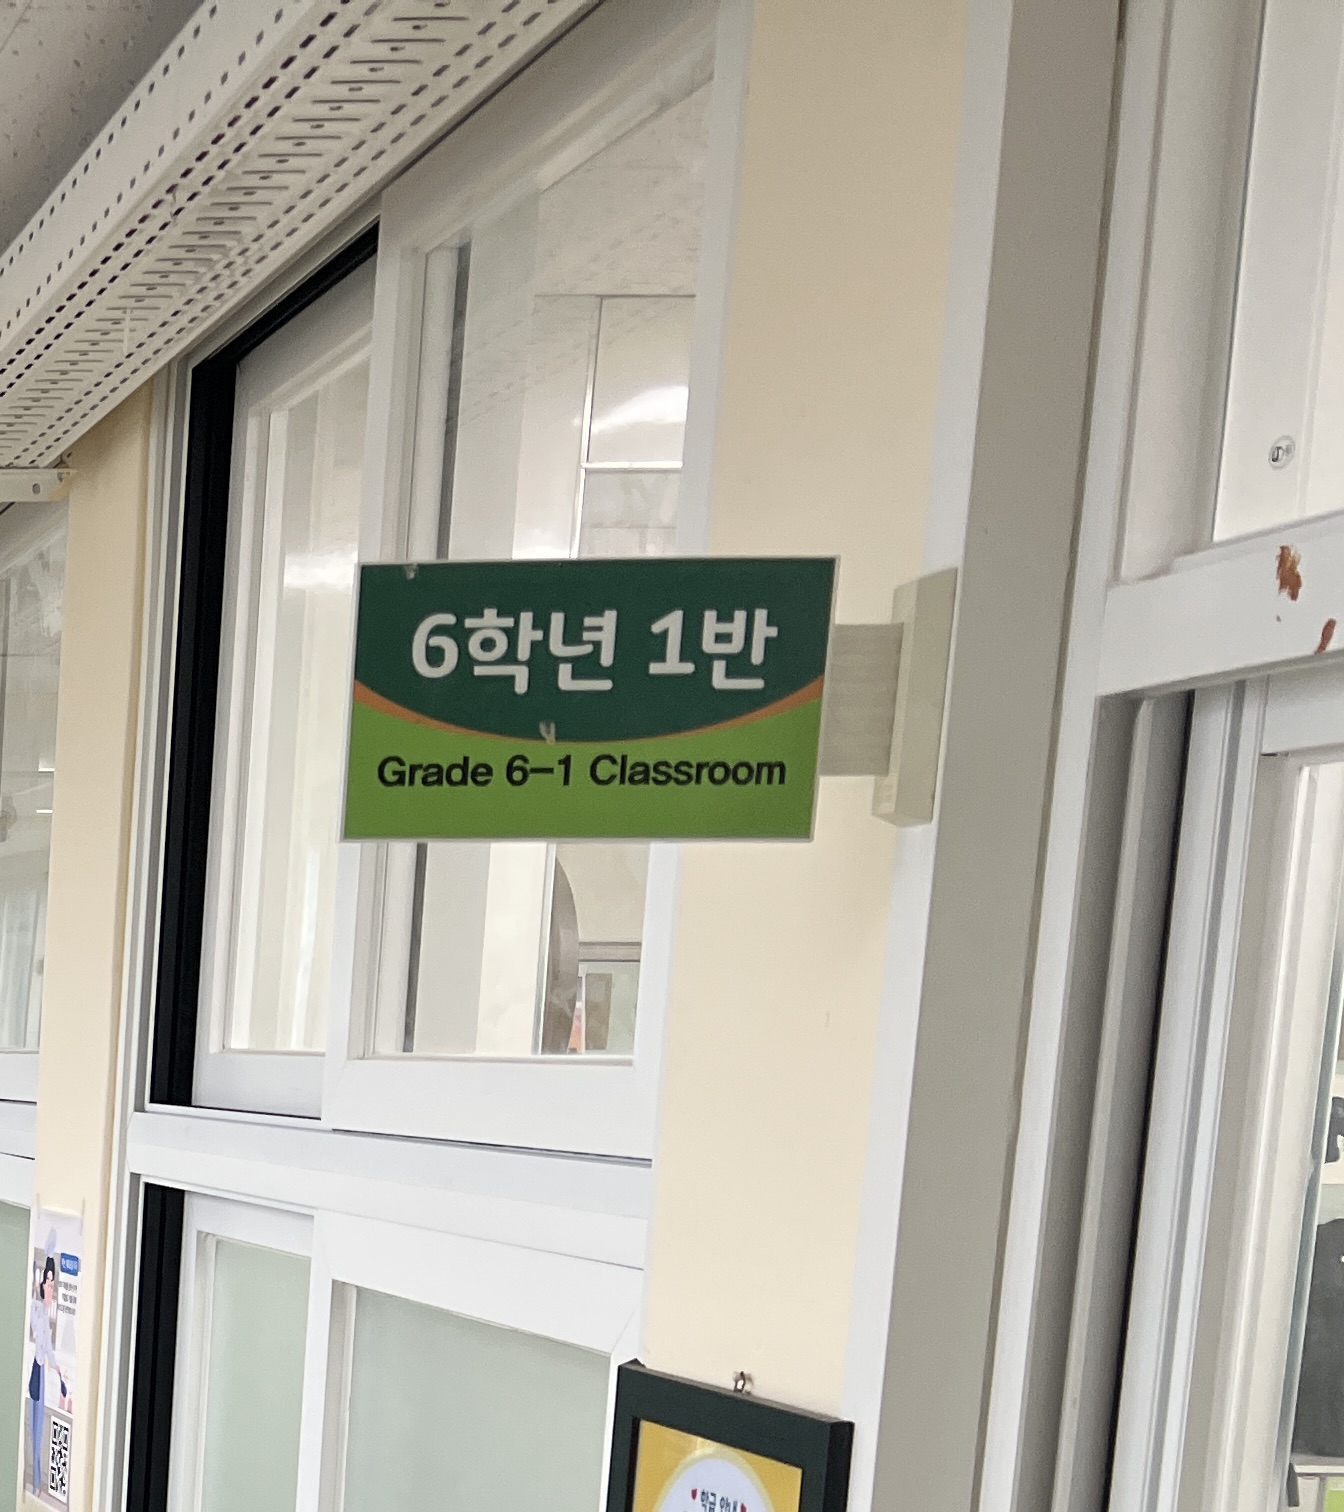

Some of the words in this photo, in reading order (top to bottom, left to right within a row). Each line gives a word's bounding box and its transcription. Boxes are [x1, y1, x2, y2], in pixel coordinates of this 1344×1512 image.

[411, 607, 618, 695] 6학년
[647, 608, 779, 691] 1반
[376, 755, 494, 788] Grade
[504, 754, 573, 787] 6-1
[589, 754, 787, 787] Classroom
